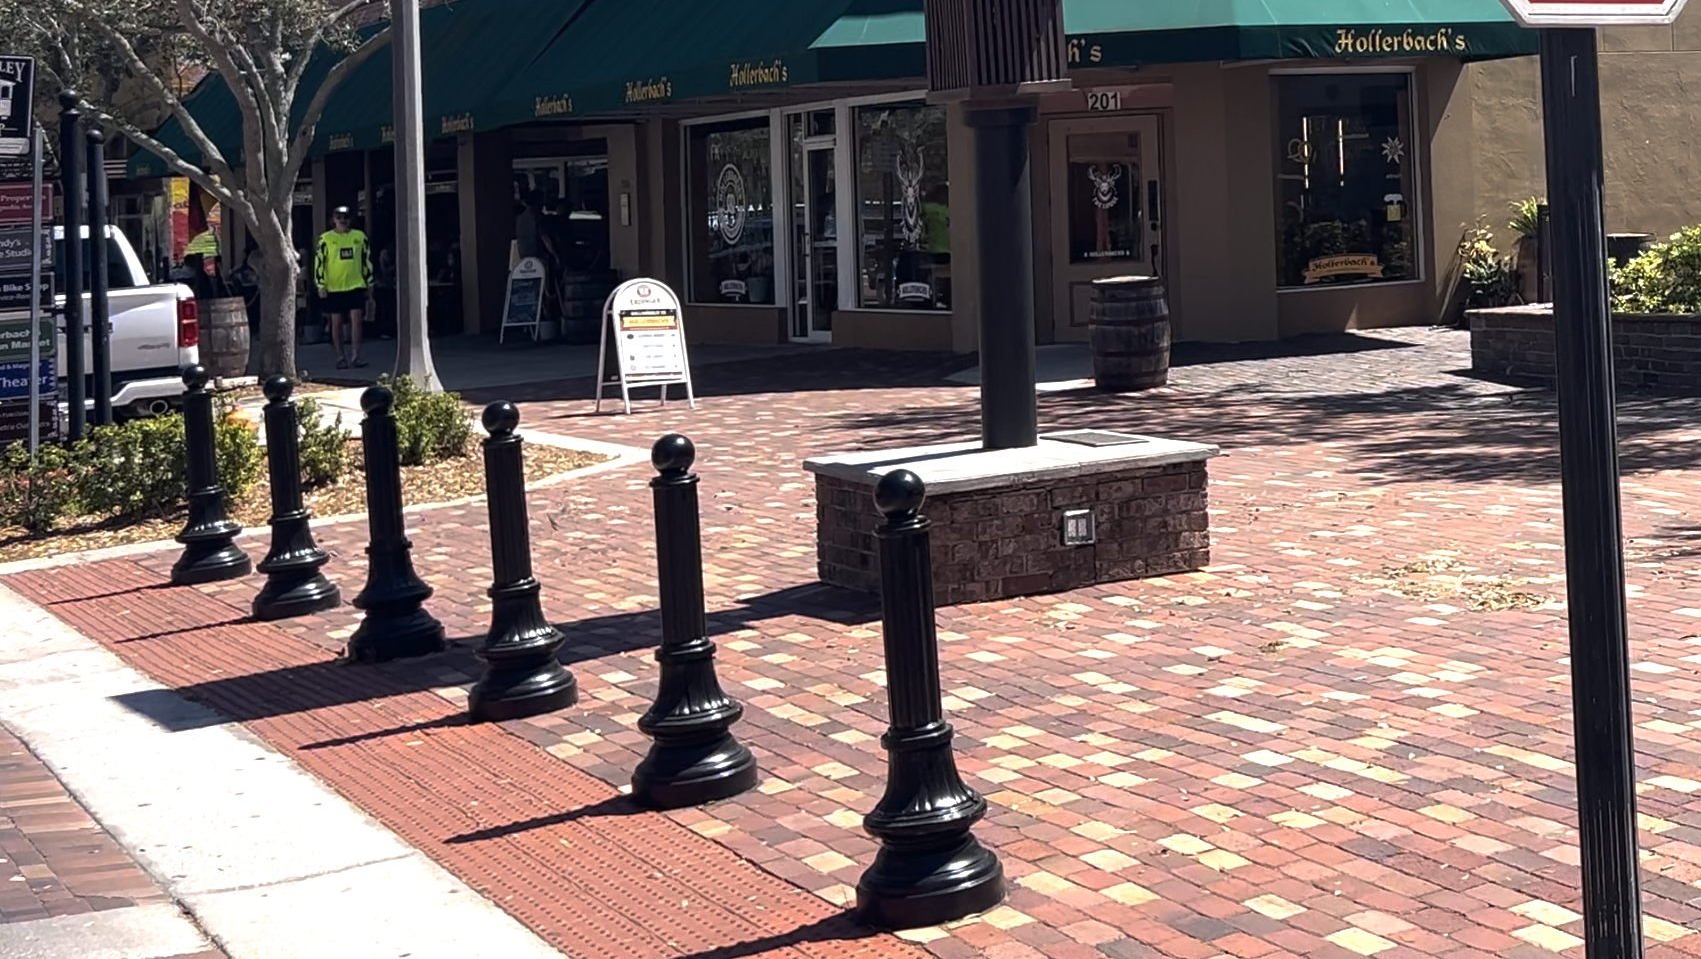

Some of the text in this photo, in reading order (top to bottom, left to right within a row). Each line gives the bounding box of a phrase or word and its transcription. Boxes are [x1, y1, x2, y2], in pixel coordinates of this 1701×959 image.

[1335, 28, 1467, 54] Hollerbach's
[729, 59, 788, 87] Hollerbach's
[625, 76, 672, 103] Hollerbach's
[1088, 92, 1121, 111] 201
[3, 284, 24, 292] Bike
